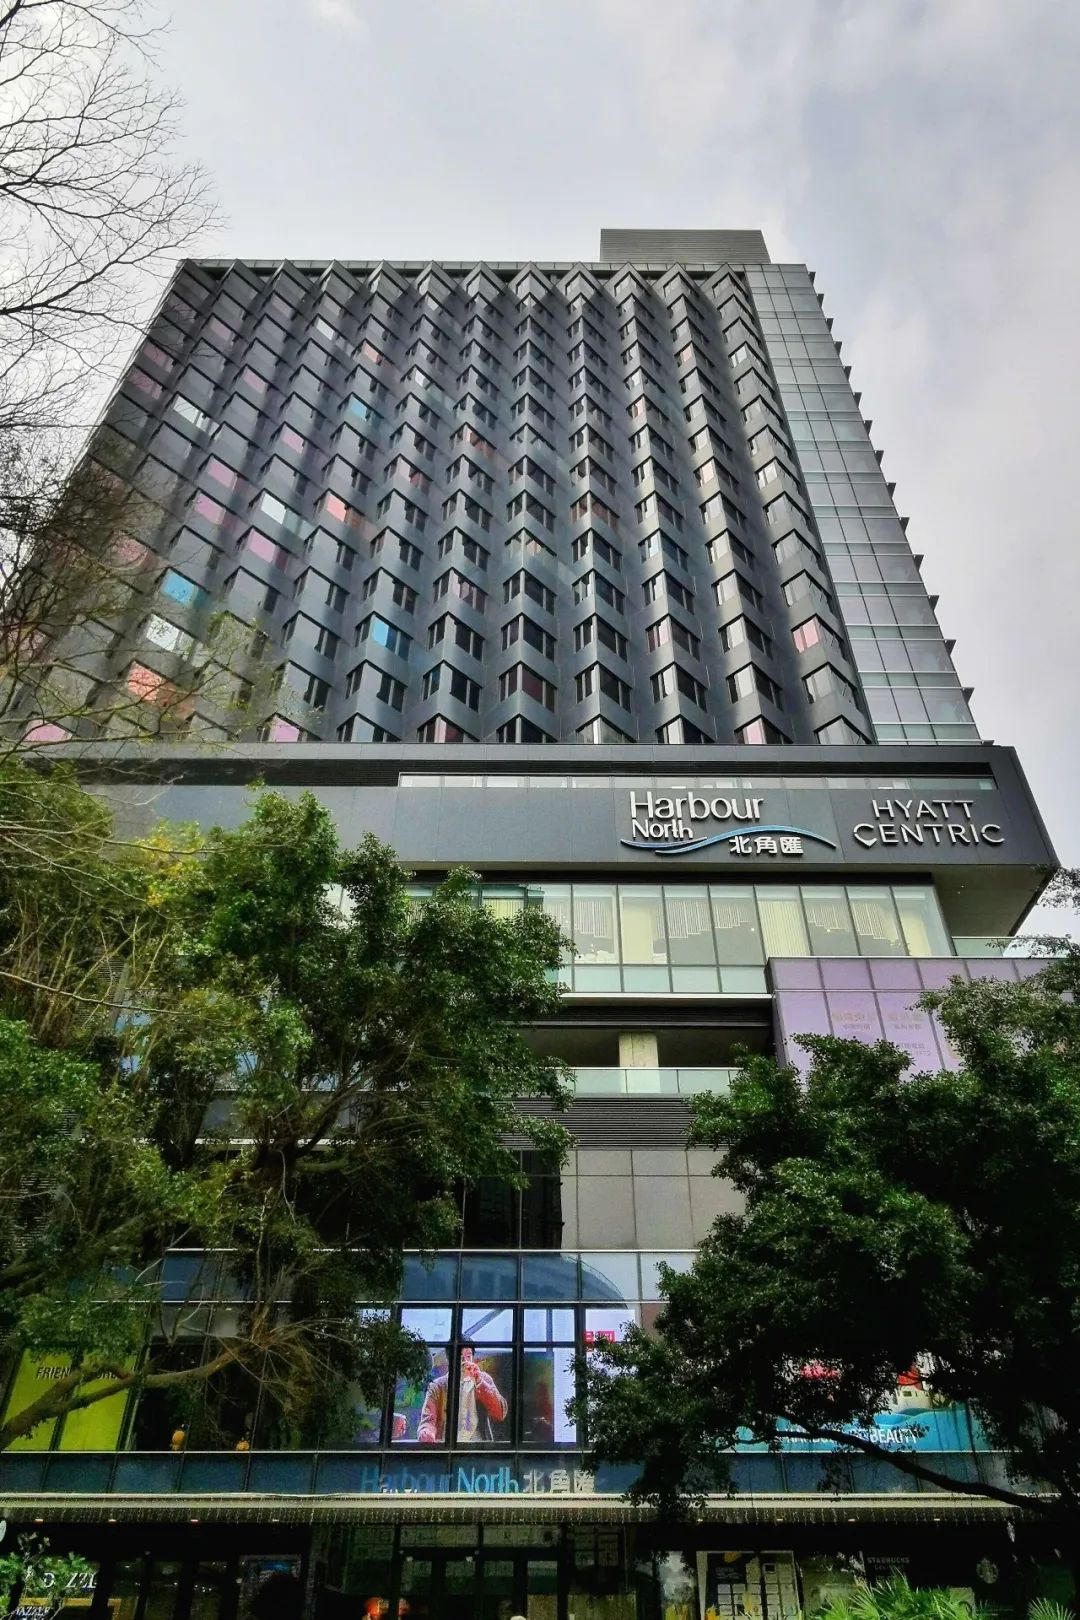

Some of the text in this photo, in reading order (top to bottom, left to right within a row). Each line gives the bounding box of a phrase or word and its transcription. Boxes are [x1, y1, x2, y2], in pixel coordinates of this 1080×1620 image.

[629, 791, 764, 820] Harbour
[872, 799, 975, 820] HYATT
[631, 819, 693, 840] North
[853, 822, 1006, 847] CENTRIC
[729, 835, 804, 854] 北角匯
[361, 1466, 519, 1493] Harbour North
